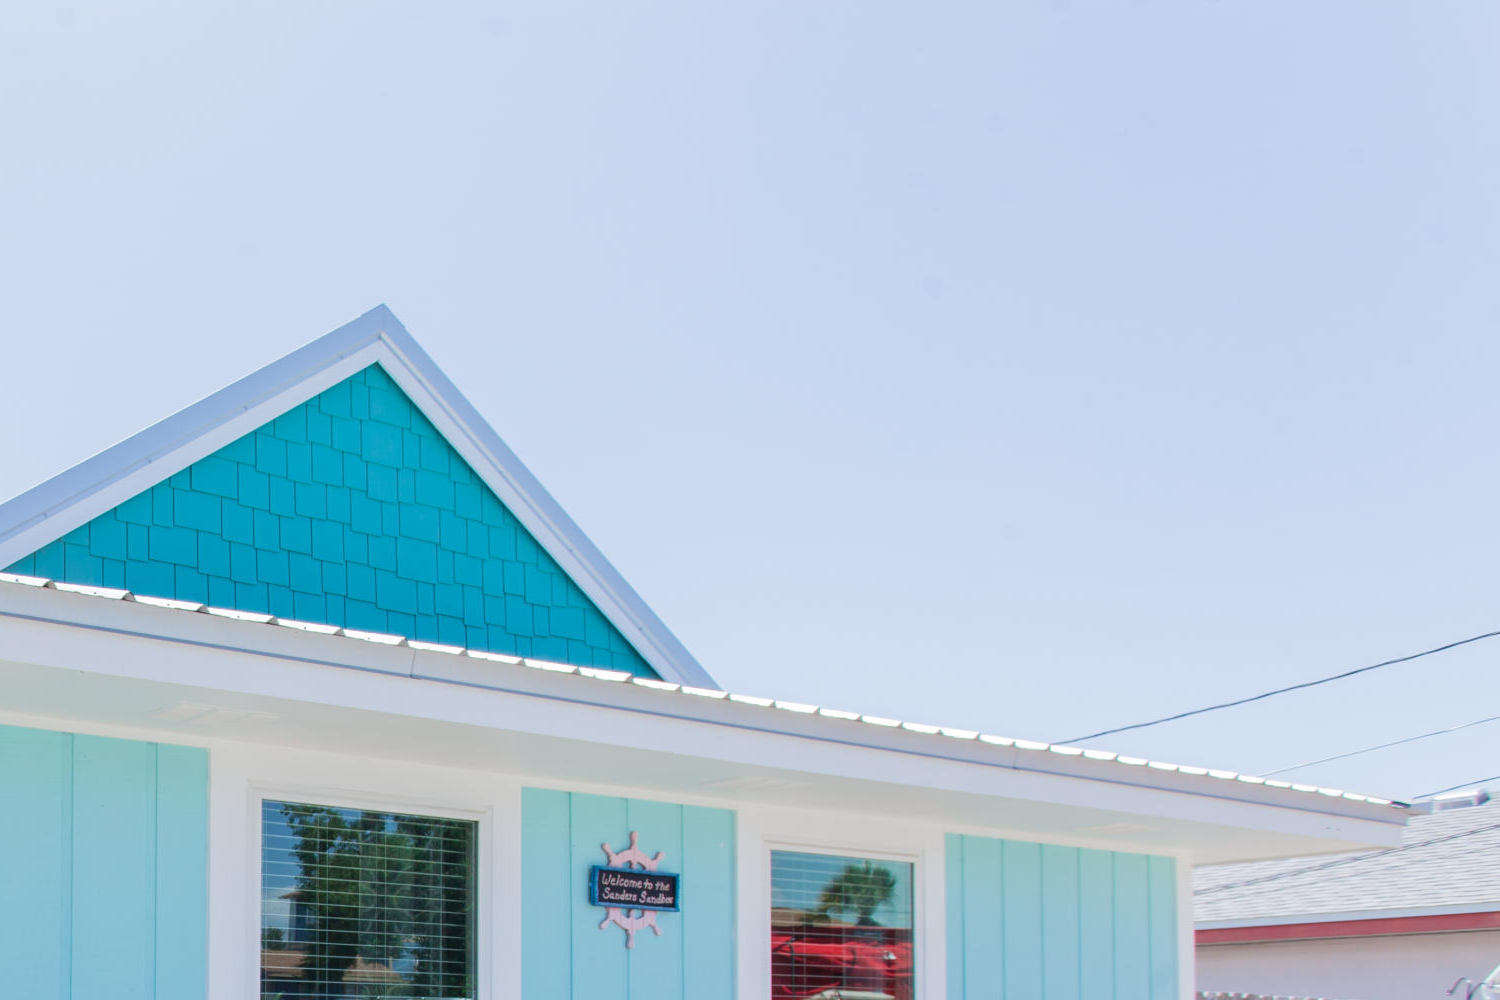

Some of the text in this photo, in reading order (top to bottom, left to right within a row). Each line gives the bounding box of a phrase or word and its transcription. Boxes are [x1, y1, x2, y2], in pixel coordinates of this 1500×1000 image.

[601, 873, 670, 891] Welcome to the
[602, 887, 637, 902] Sanders
